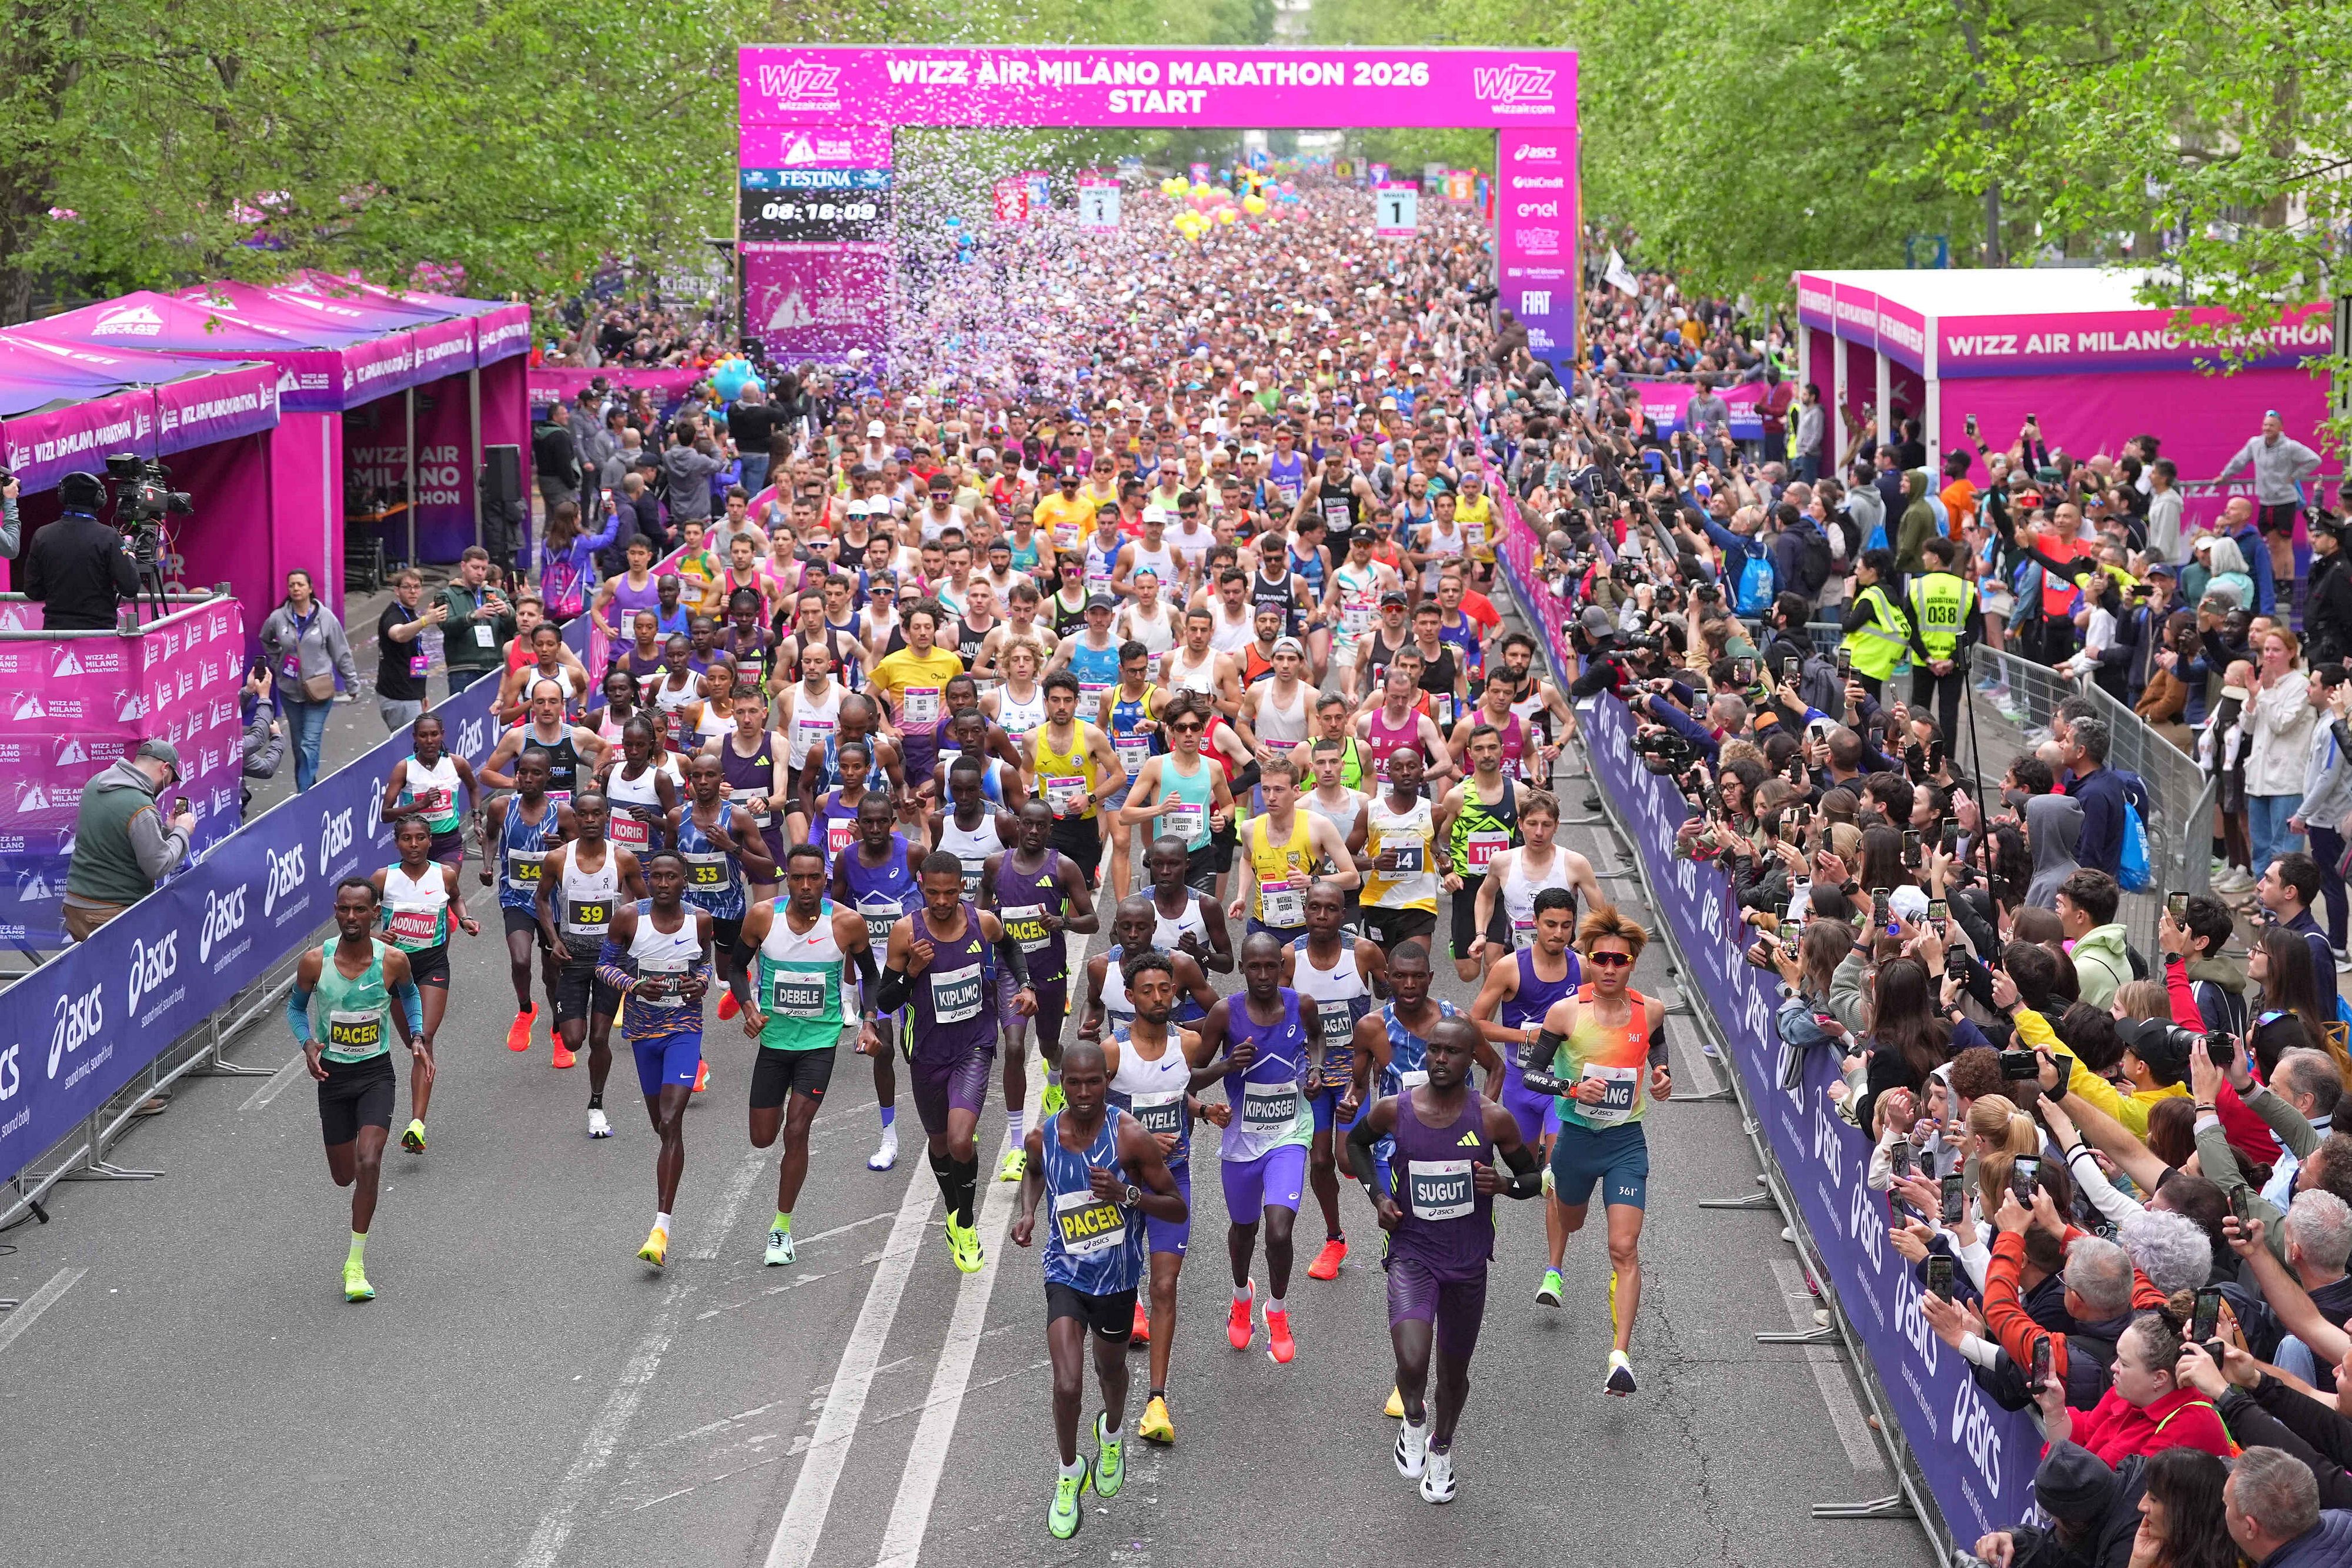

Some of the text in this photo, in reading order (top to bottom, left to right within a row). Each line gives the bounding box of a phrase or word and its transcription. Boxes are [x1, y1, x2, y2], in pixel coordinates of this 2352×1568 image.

[886, 61, 1429, 86] WIZZ AIR MILANO MARATHON 2026
[777, 101, 841, 111] wizzair.com
[1108, 89, 1207, 113] START
[1491, 103, 1556, 115] wizzair.com
[780, 170, 850, 186] FESTINA
[1523, 176, 1563, 188] UniCredit
[762, 203, 876, 220] 08:16:09
[1391, 202, 1401, 223] 1
[1517, 200, 1558, 218] enel
[1521, 290, 1552, 315] FIAT
[1947, 335, 2017, 356] WIZZ
[2024, 333, 2070, 354] AIR
[2077, 330, 2180, 352] MILANO
[419, 446, 459, 463] AIR
[1255, 593, 1288, 603] RUNAWAY
[1927, 606, 1957, 623] 038
[960, 641, 983, 654] ANTW
[614, 823, 643, 840] KORIR
[832, 834, 854, 848] KALA
[519, 864, 542, 880] 34
[696, 867, 718, 882] 33
[1276, 896, 1292, 904] MATHIAS
[1278, 904, 1293, 912] 13104
[580, 907, 604, 922] 39
[866, 920, 894, 934] BOIT
[1006, 921, 1047, 942] PACER
[780, 989, 819, 1005] DEBELE
[938, 983, 978, 1007] KIPLIMO
[141, 1006, 154, 1028] sound
[162, 989, 175, 1011] sound
[174, 984, 186, 1002] body
[1324, 1017, 1349, 1034] AGAT
[65, 1065, 79, 1090] sound
[91, 1045, 106, 1071] sound
[105, 1041, 113, 1060] body
[1602, 1087, 1629, 1105] ANG
[1245, 1100, 1295, 1118] KIPKOSGEI
[2, 1105, 30, 1138] sound body
[1141, 1110, 1177, 1130] AYELE
[1418, 1179, 1465, 1202] SUGUT
[1619, 1186, 1638, 1196] 361°
[1062, 1204, 1122, 1240] PACER
[1902, 1360, 1913, 1388] sound
[1920, 1393, 1931, 1420] sound
[1929, 1406, 1937, 1439] body
[1962, 1475, 1975, 1507] sound
